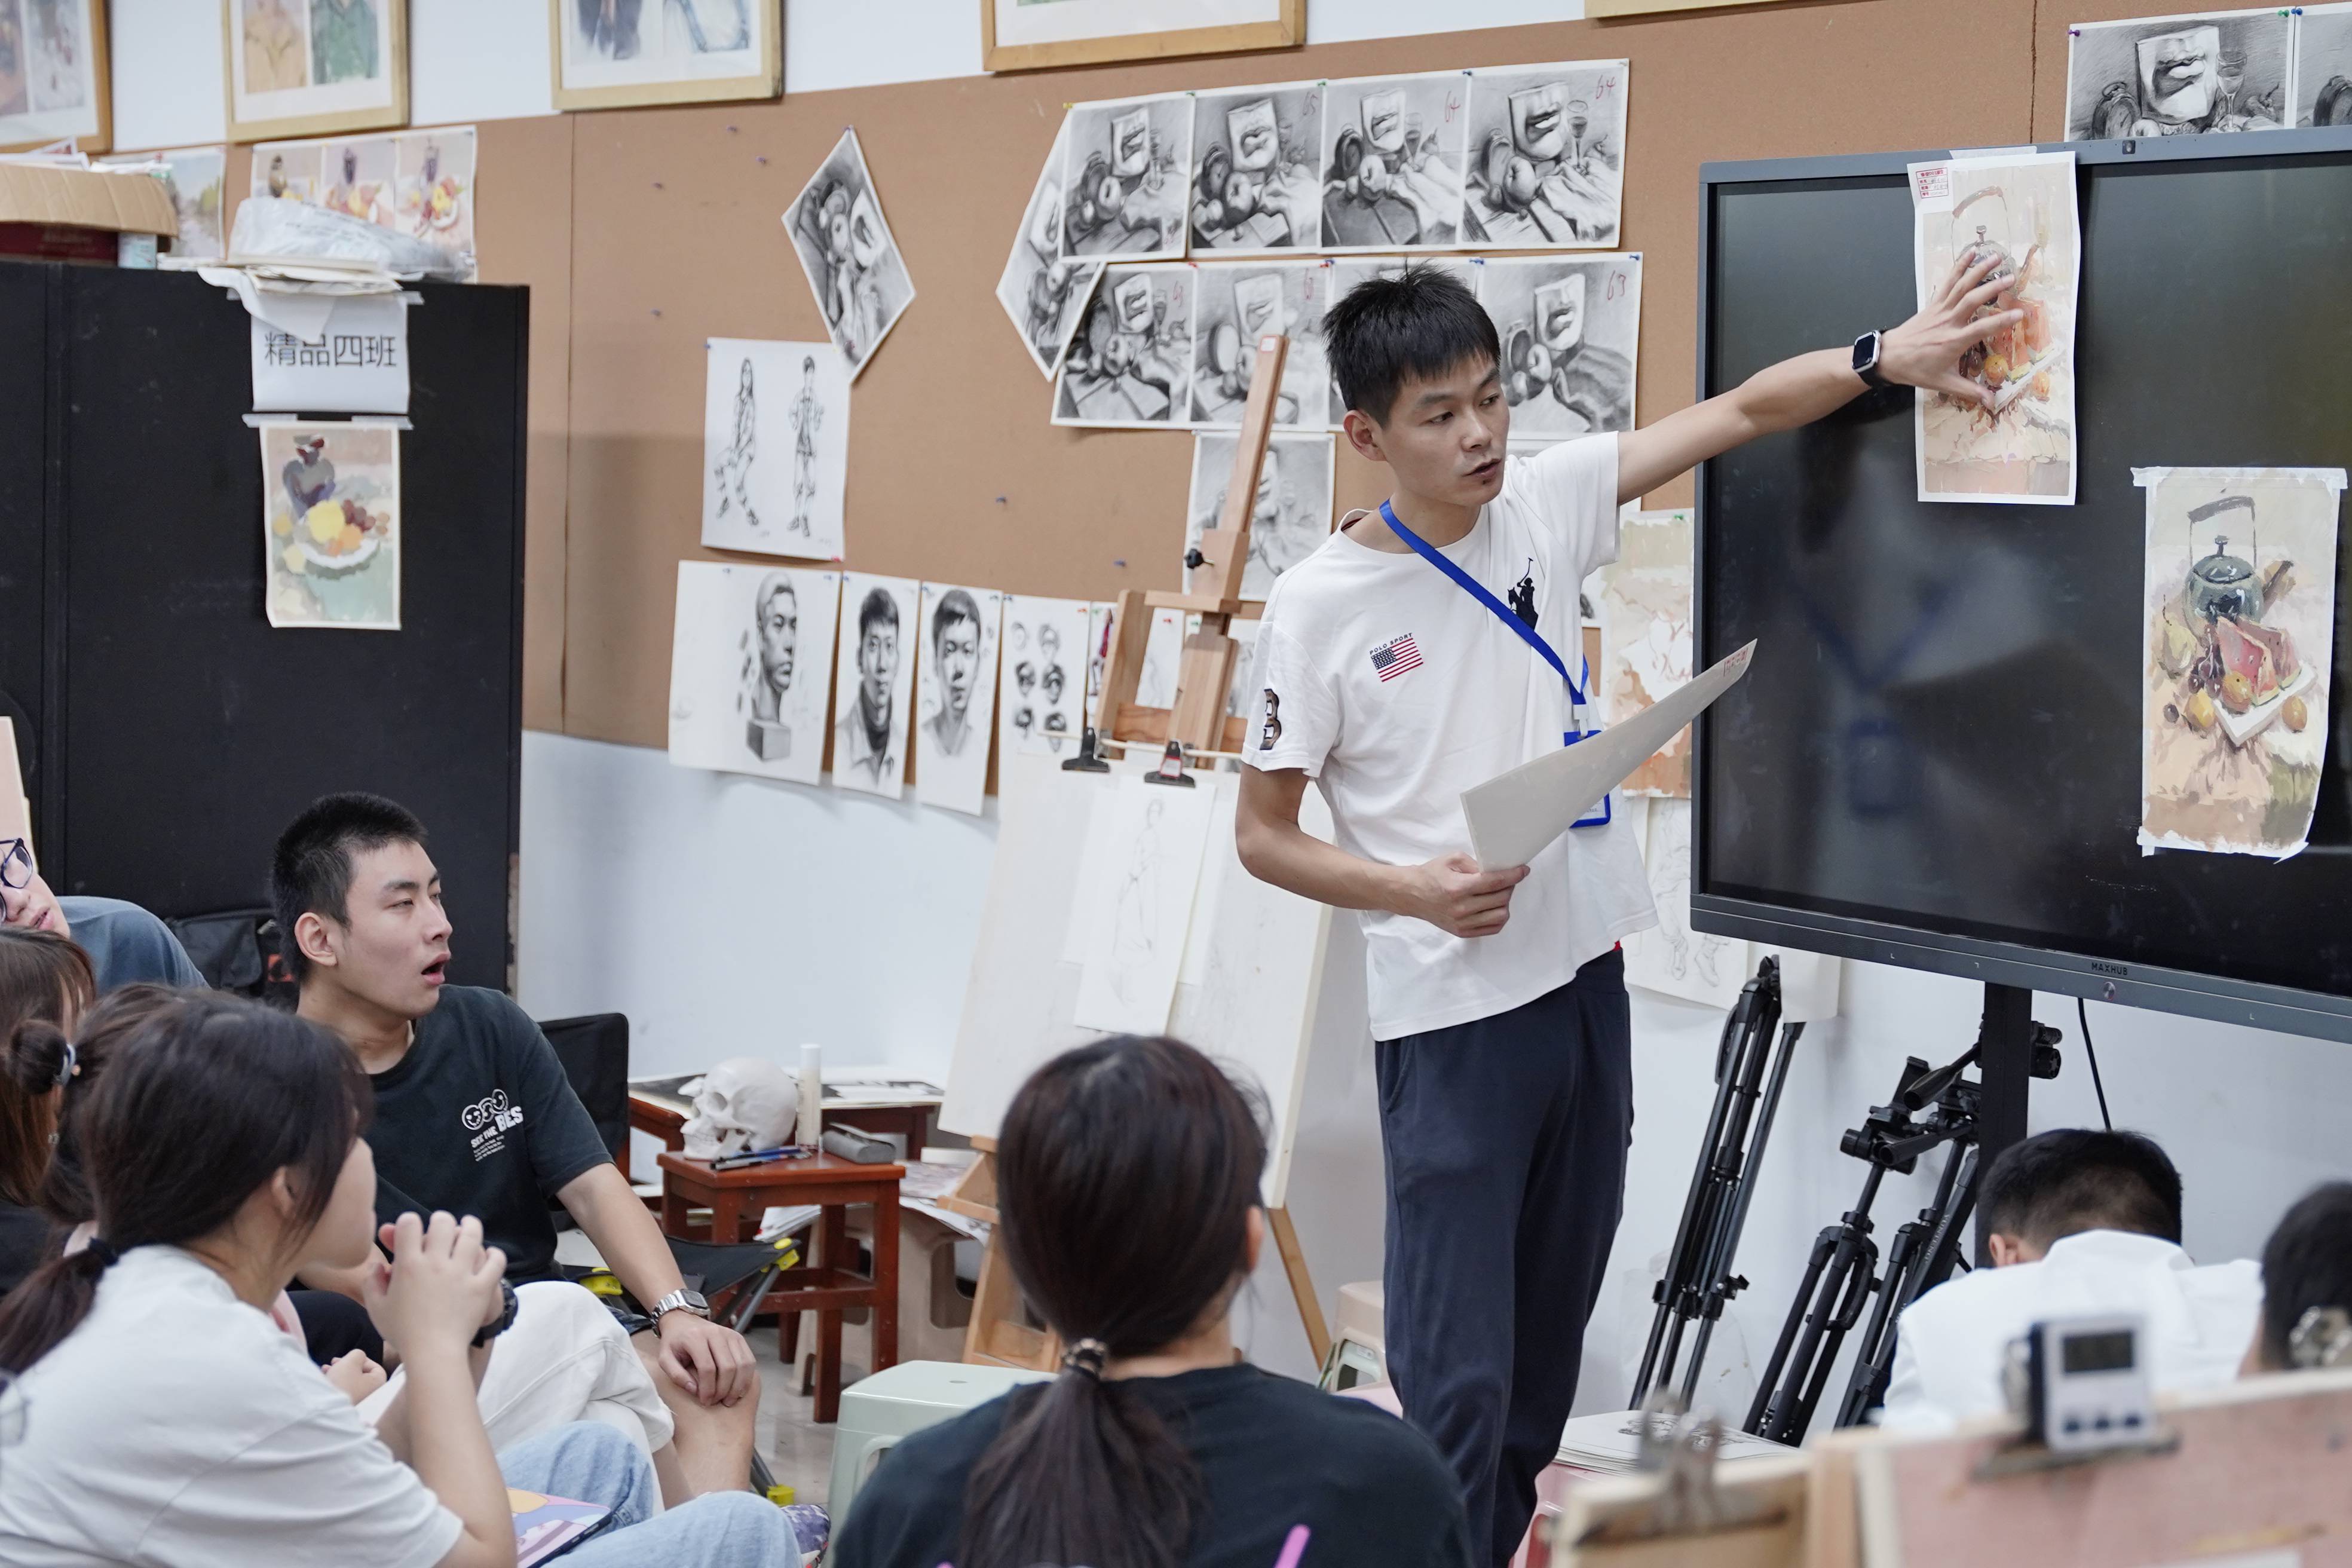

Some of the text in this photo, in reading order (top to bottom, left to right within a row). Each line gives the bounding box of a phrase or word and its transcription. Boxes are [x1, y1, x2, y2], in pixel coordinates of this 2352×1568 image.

[1596, 75, 1616, 99] 64
[265, 332, 397, 367] 精品四班
[1369, 632, 1413, 655] POLO SPORT
[1259, 688, 1282, 751] B
[2091, 962, 2128, 976] MAXHUB
